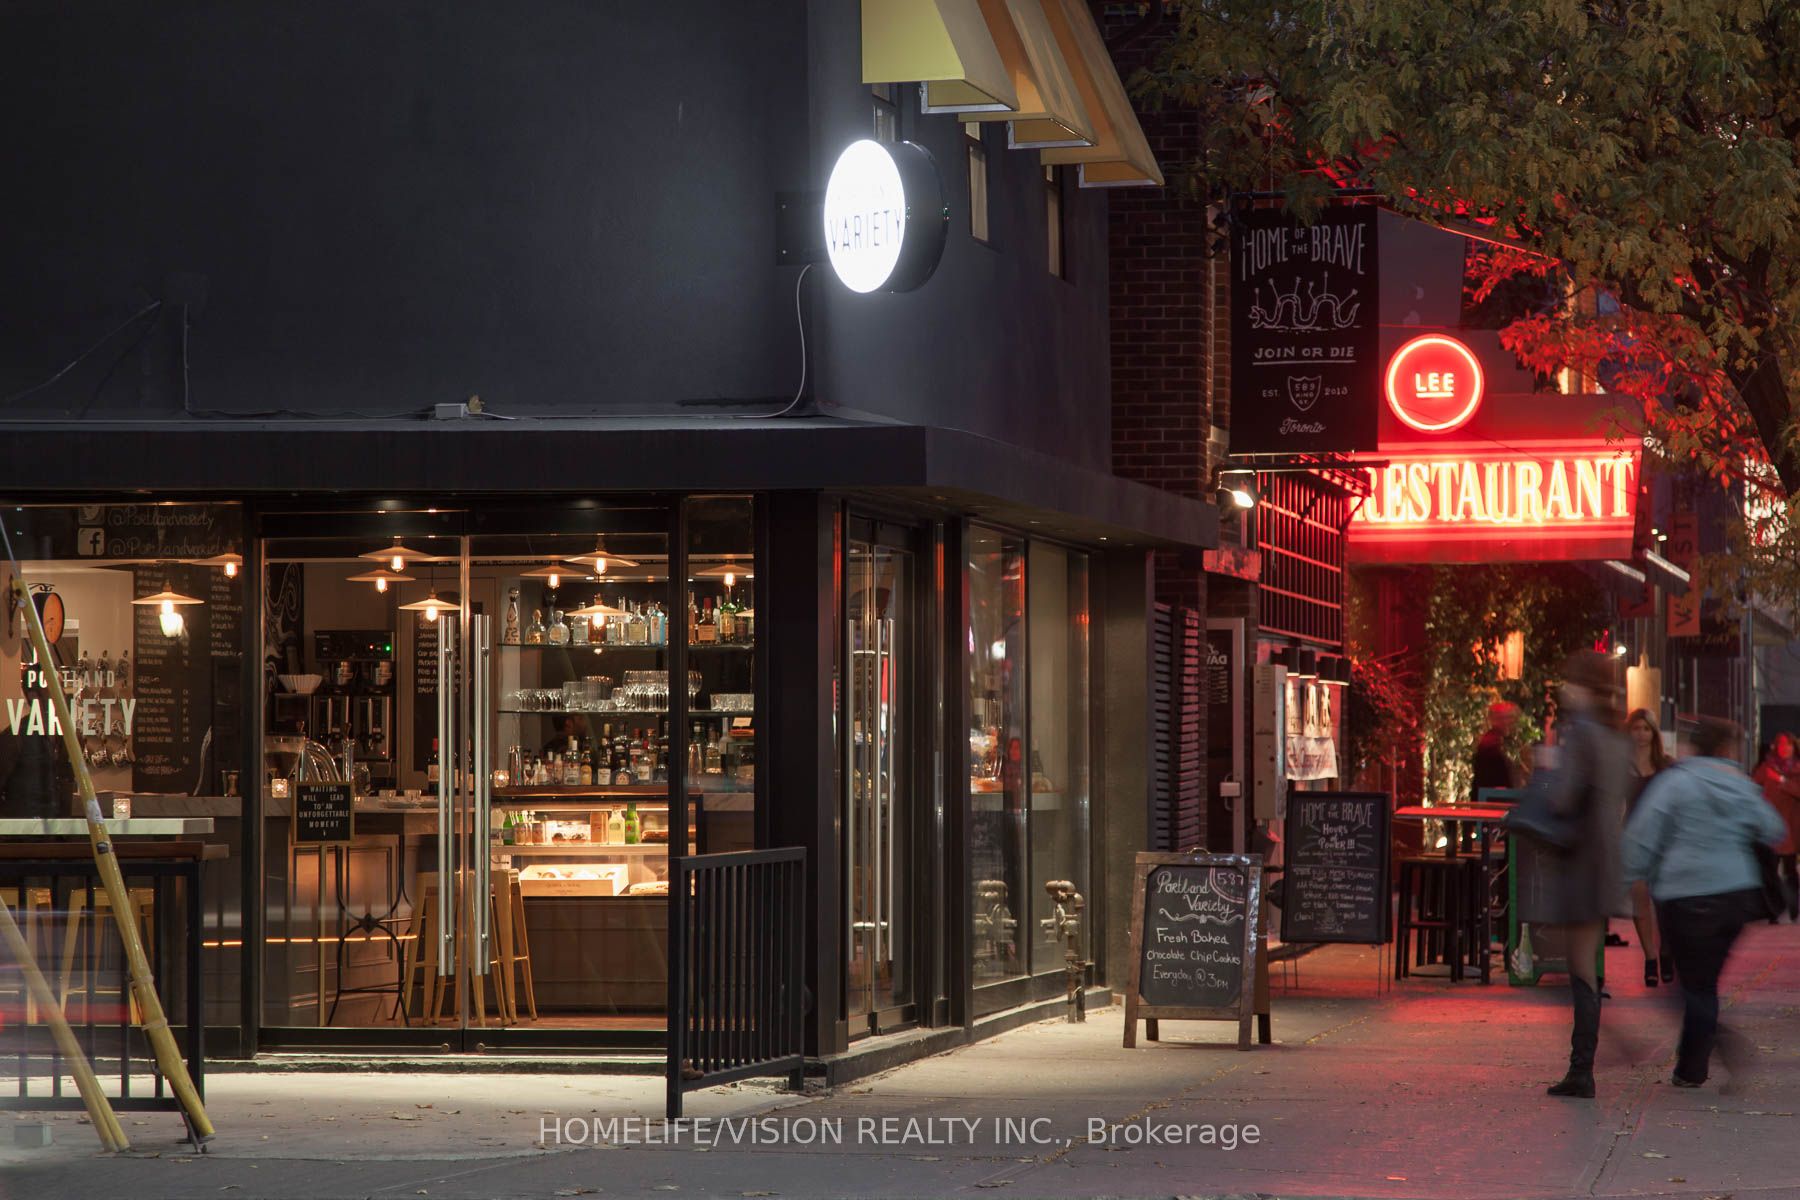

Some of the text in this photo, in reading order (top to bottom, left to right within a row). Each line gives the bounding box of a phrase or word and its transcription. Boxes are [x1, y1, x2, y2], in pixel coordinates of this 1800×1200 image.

[830, 208, 902, 253] VARIETY
[1242, 223, 1366, 281] HOME OF THE BRAVE
[1254, 345, 1355, 359] JOIN OR DIE
[1415, 372, 1455, 392] LEE
[1279, 417, 1327, 435] Toronto
[1350, 456, 1634, 524] RESTAURANT
[303, 794, 344, 802] WILL LEAD
[299, 810, 349, 818] UNFORGETTABLE
[1300, 802, 1328, 828] HOME
[1342, 802, 1376, 828] BRAVE
[309, 820, 339, 828] MOMENT
[1217, 872, 1245, 886] 587
[1156, 927, 1229, 945] Fresh Baked
[1190, 950, 1212, 963] Chip
[1212, 950, 1241, 965] Cookies
[1153, 963, 1193, 990] Everyday
